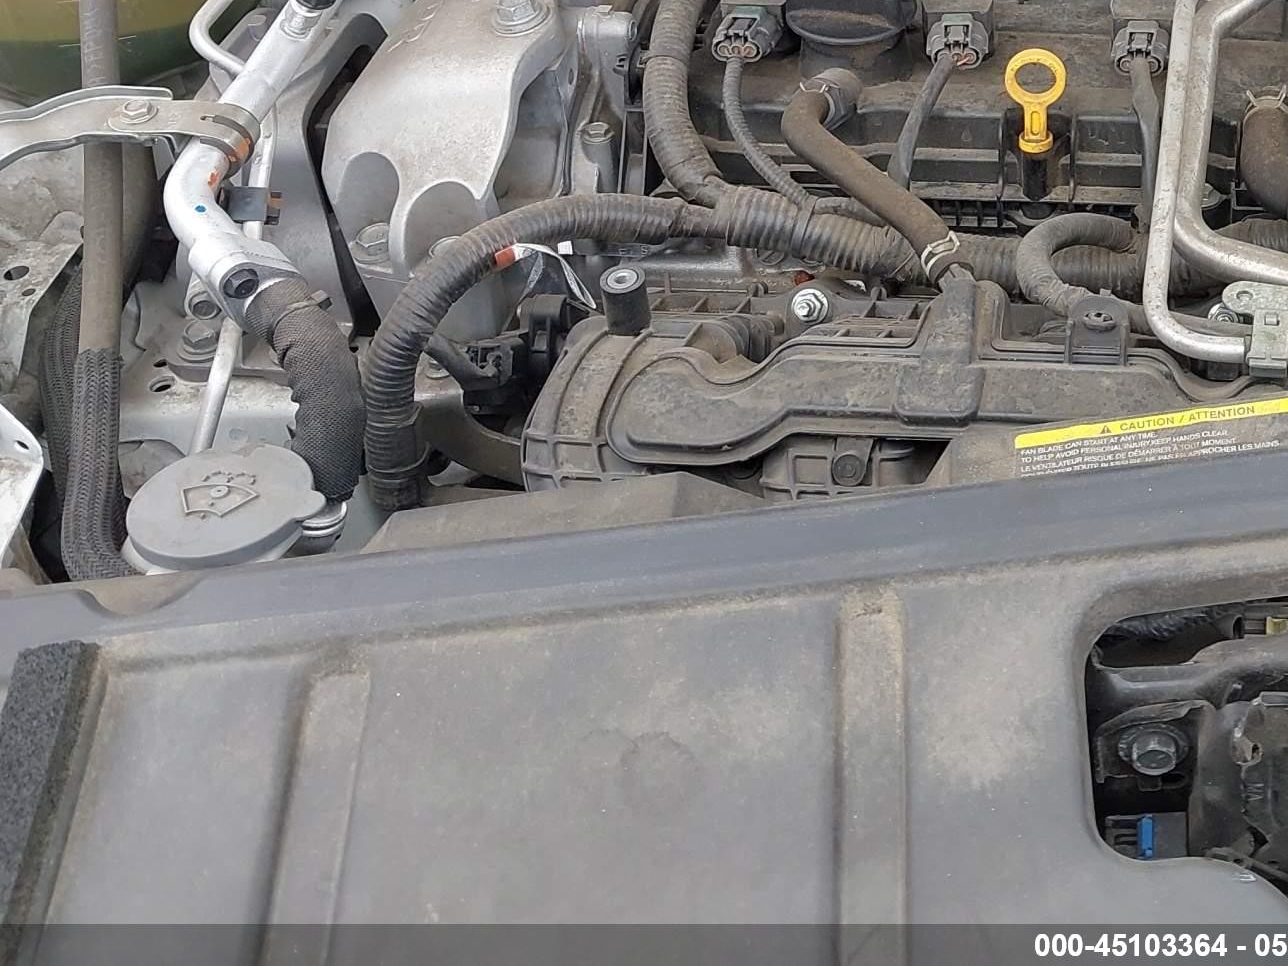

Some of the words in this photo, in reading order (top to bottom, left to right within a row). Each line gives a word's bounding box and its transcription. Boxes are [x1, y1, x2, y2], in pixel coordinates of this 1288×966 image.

[1119, 416, 1175, 432] CAUTION
[1188, 405, 1256, 422] ATTENTION
[1020, 465, 1031, 473] LE
[1115, 451, 1127, 459] DE
[1180, 441, 1200, 450] TOUT
[1033, 453, 1054, 462] HELP
[1055, 449, 1080, 459] AVOID
[1080, 444, 1122, 454] PERSONAL
[1172, 432, 1200, 442] HANDS
[1037, 444, 1063, 454] BLADE
[1064, 441, 1082, 450] CAN
[1083, 438, 1107, 446] START
[1109, 436, 1119, 444] AT
[1120, 434, 1138, 442] ANY
[1237, 443, 1253, 452] LES
